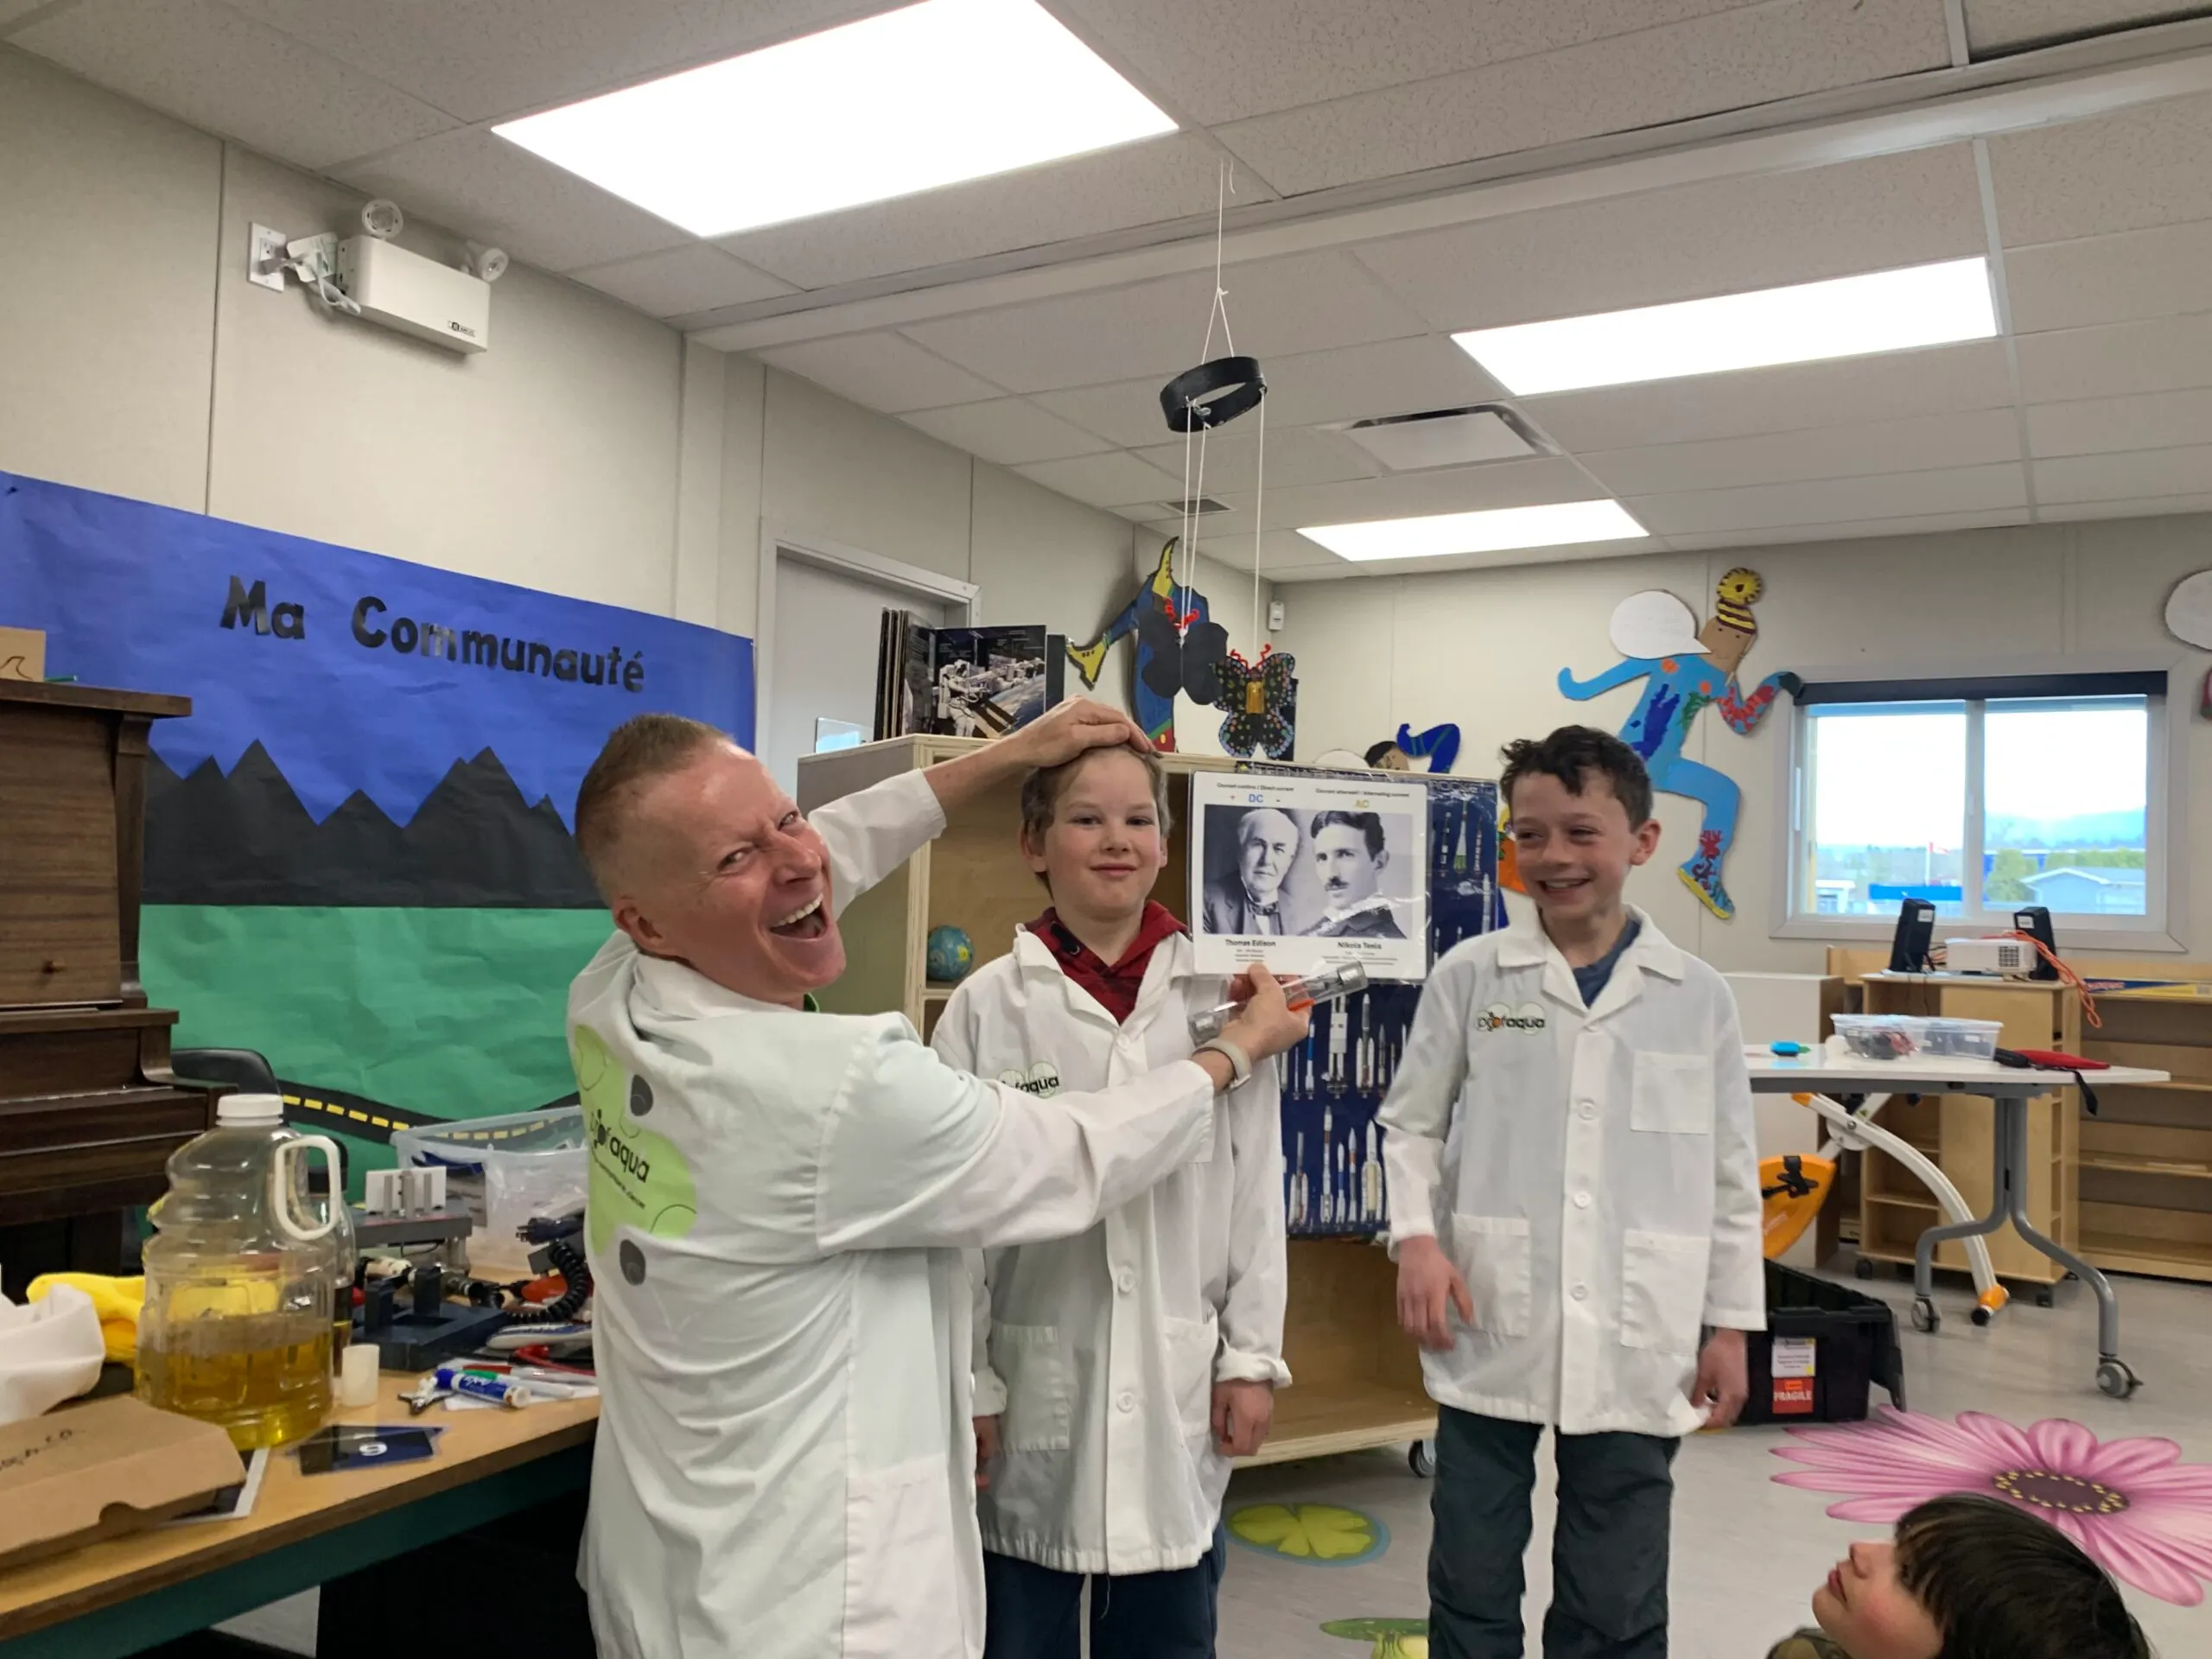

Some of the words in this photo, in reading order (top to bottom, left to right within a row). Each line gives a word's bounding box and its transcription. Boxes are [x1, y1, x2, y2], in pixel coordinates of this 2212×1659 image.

[219, 575, 305, 640] Ma
[352, 595, 645, 692] Communauté
[1249, 793, 1263, 803] DC
